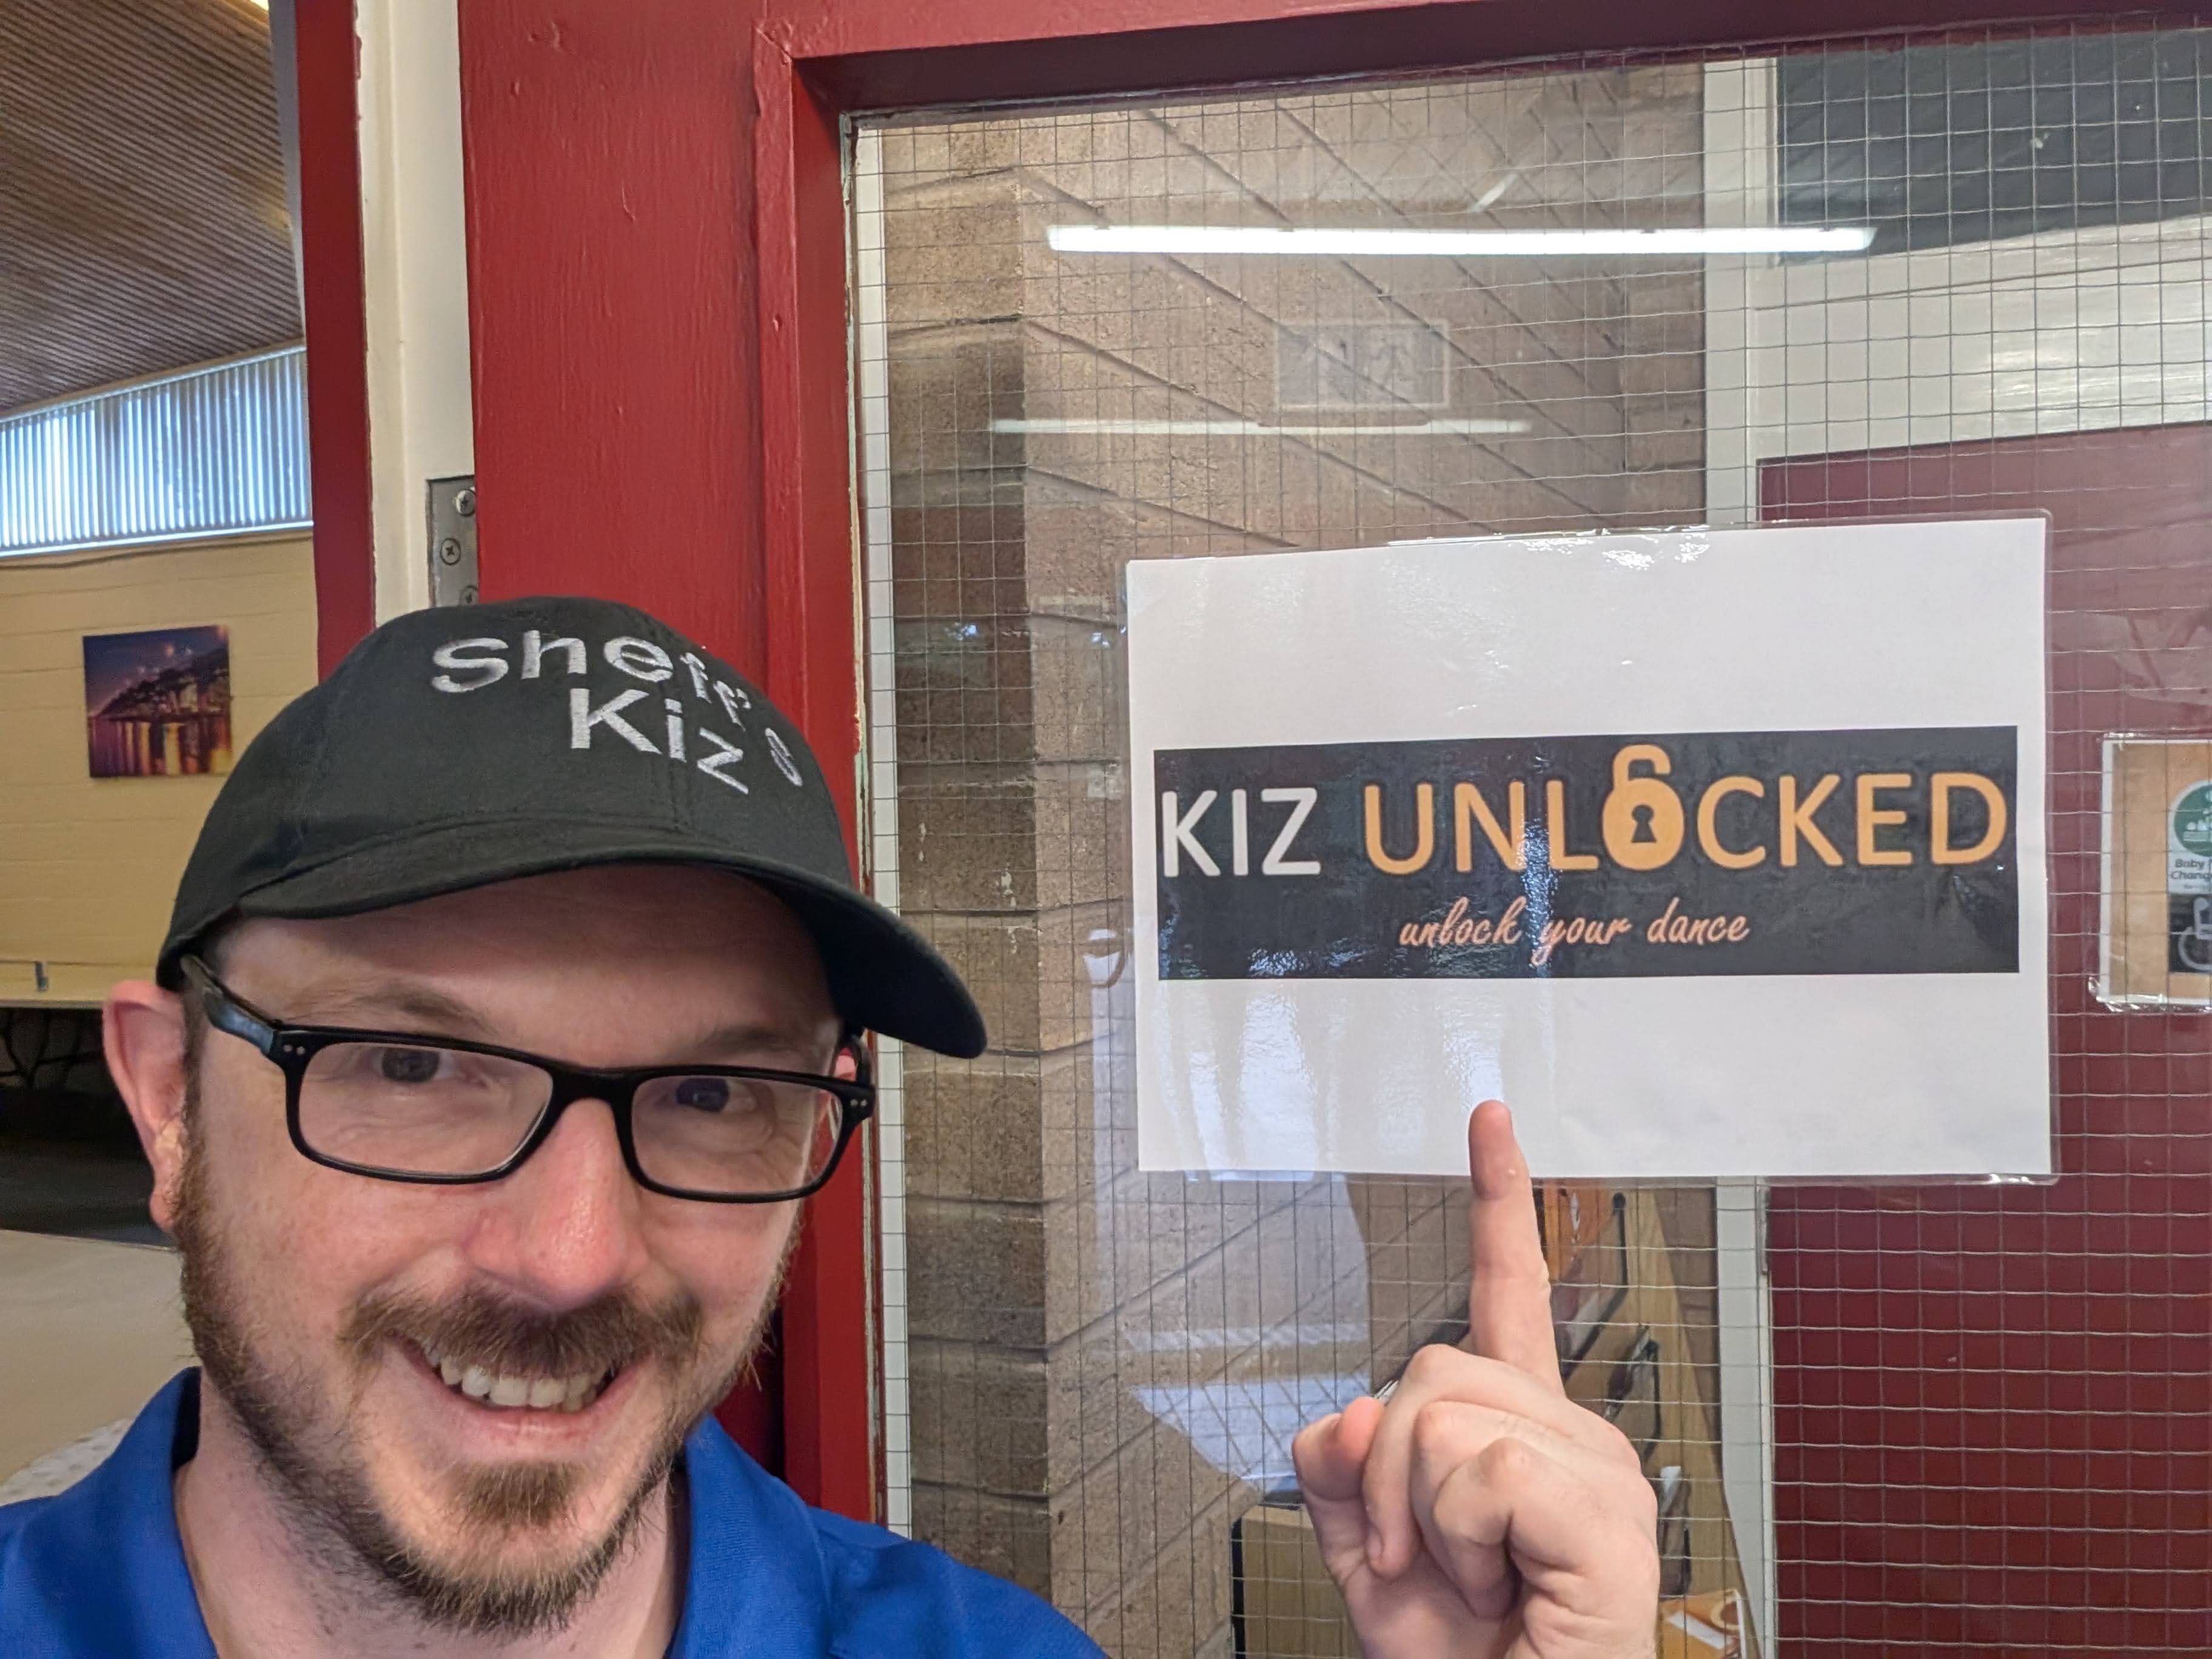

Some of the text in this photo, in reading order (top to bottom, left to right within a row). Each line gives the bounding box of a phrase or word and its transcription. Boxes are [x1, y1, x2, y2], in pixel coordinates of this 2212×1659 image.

[570, 687, 749, 794] Kiz
[1161, 743, 2008, 877] KIZ UNLOCKED
[2170, 870, 2212, 883] Chang
[2174, 858, 2205, 871] Baby
[1399, 896, 1751, 966] unlock your dance
